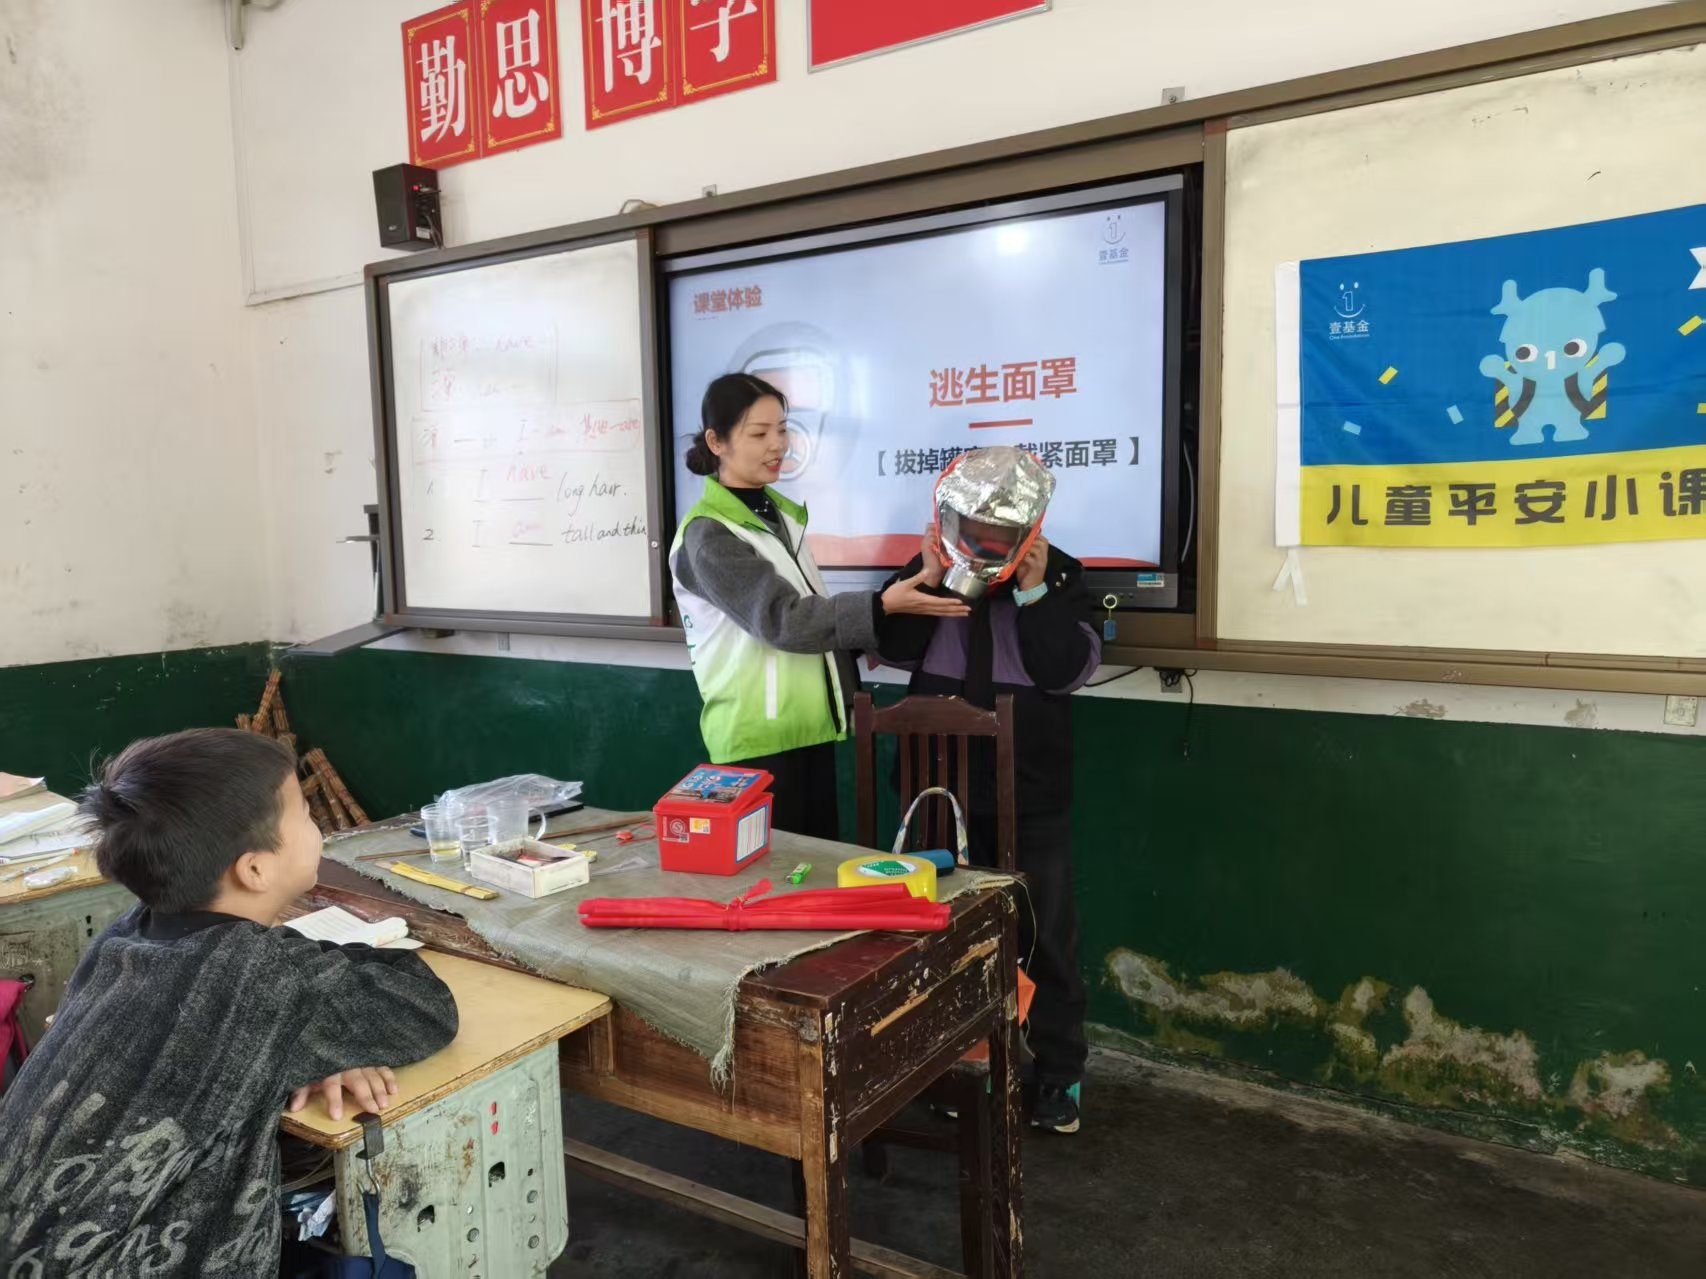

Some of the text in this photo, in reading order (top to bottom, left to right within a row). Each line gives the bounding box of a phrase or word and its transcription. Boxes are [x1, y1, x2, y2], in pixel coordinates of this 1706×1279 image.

[416, 8, 550, 143] 勤思
[694, 284, 762, 313] 课堂体验
[1329, 320, 1370, 335] 壹基金
[929, 357, 1077, 407] 逃生面罩
[556, 471, 585, 518] long
[1326, 468, 1706, 526] 儿童平安小课
[562, 527, 595, 544] tall
[597, 525, 621, 539] and
